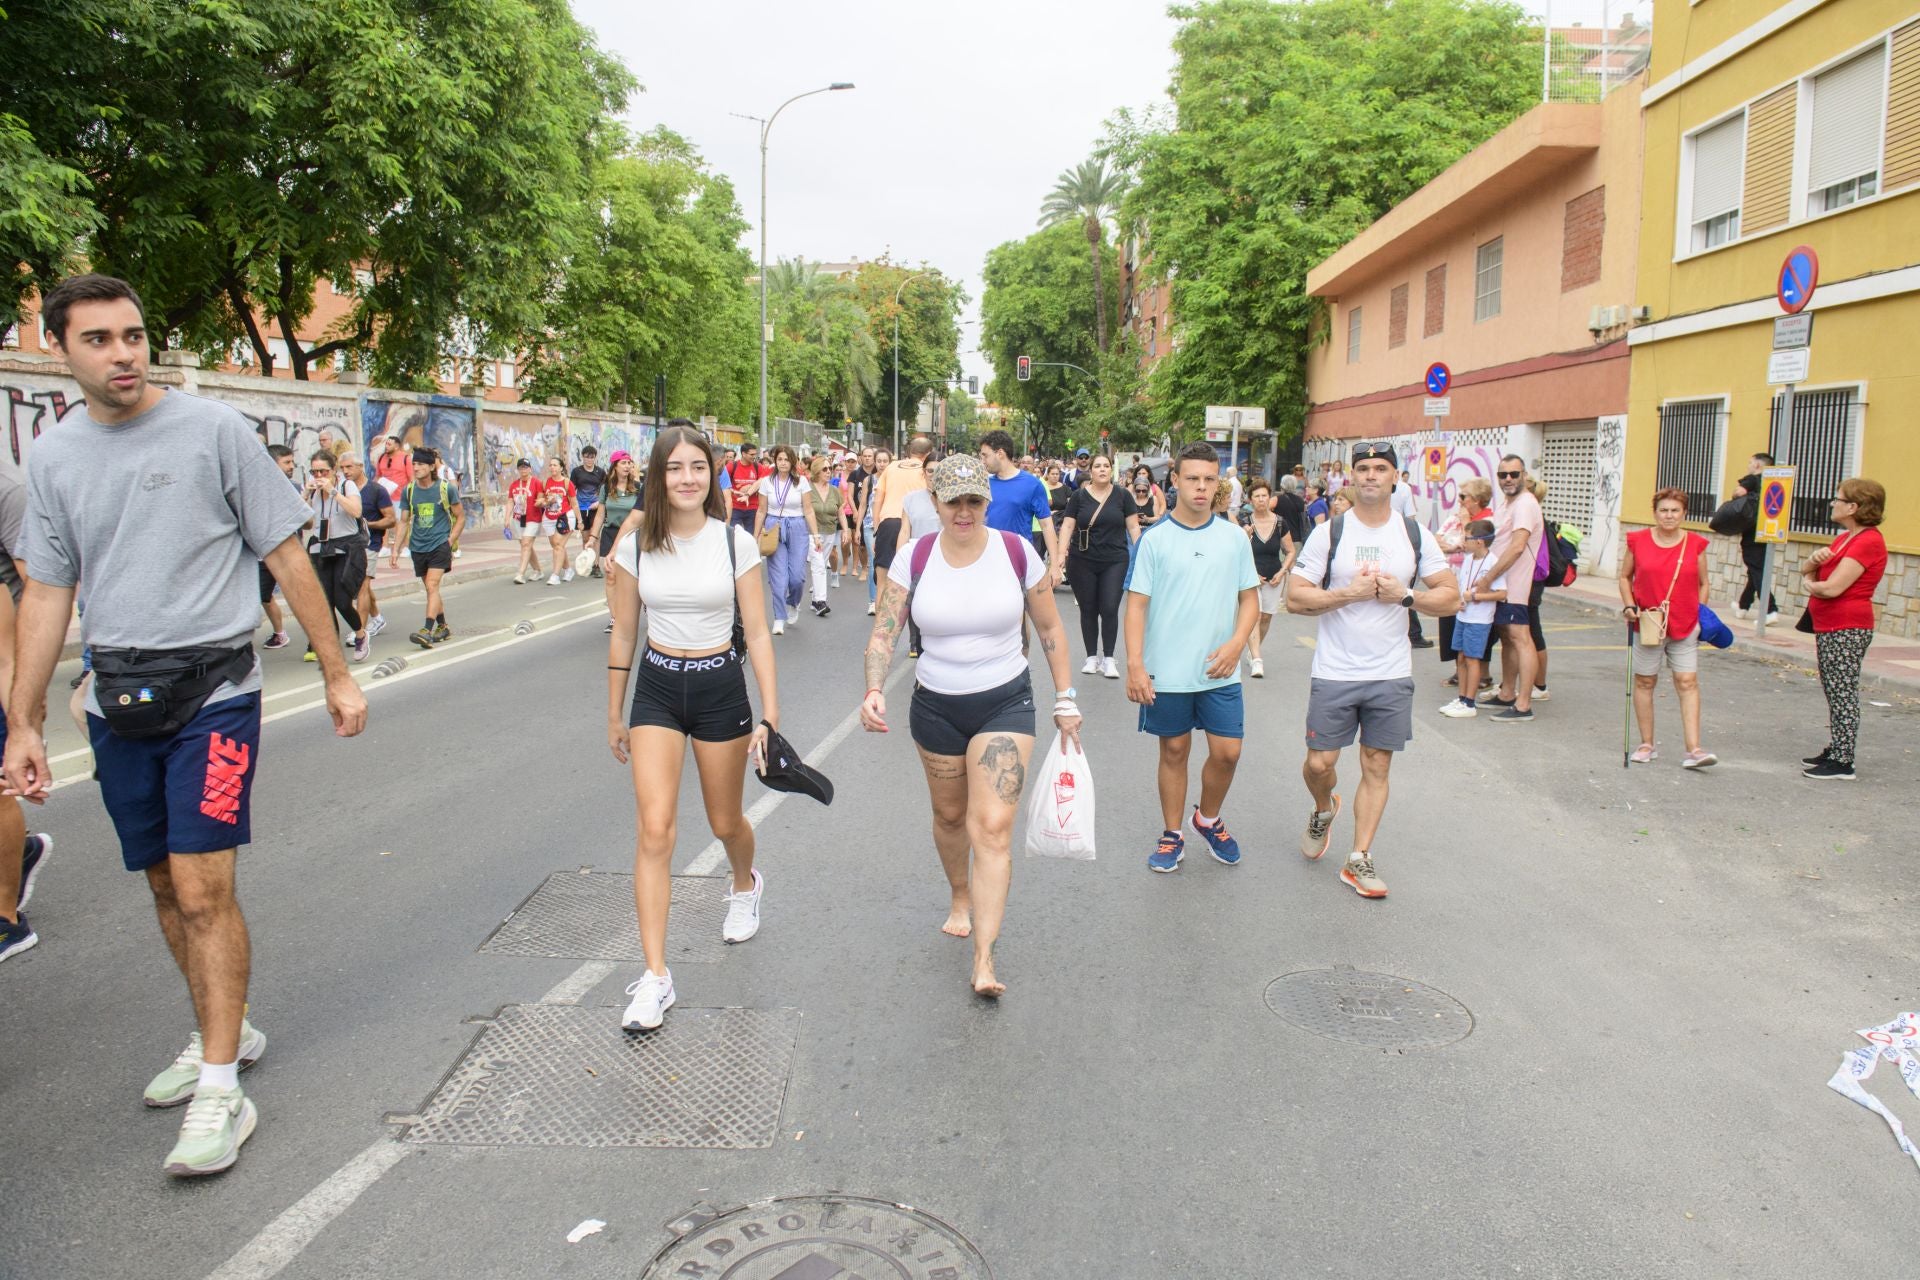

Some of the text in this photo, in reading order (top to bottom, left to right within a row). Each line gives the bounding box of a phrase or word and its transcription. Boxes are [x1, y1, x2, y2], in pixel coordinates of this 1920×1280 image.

[645, 649, 726, 672] NIKE PRO
[200, 731, 250, 825] NIKE
[675, 1209, 873, 1280] RDROLA
